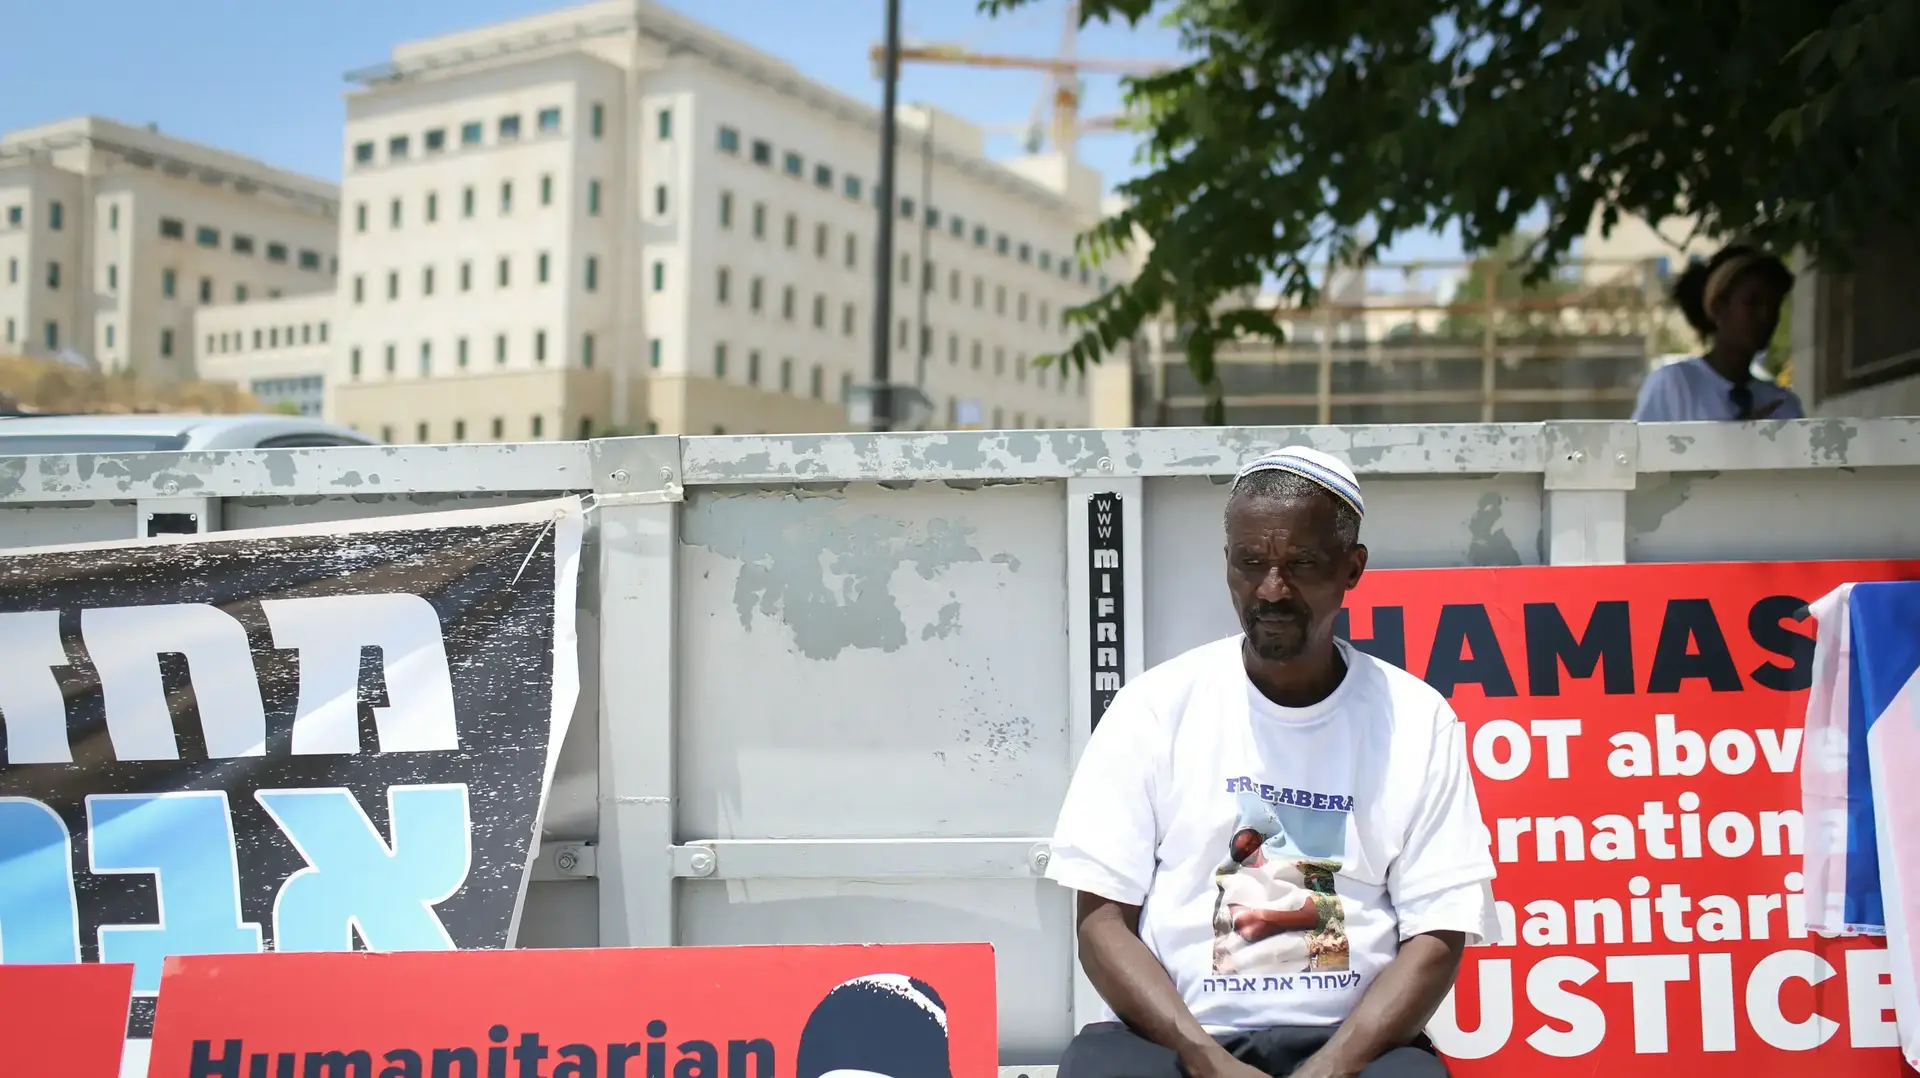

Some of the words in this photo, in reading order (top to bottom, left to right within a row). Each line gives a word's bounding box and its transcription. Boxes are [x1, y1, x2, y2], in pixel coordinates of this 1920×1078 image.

[1456, 718, 1582, 781] OT
[1226, 776, 1275, 800] FRE
[1279, 787, 1354, 812] ABERA
[1483, 791, 1846, 863] rnation
[1203, 978, 1256, 992] אברה
[1262, 976, 1293, 991] את
[1300, 971, 1361, 989] לשחרר
[1425, 949, 1901, 1060] USTICE
[189, 1019, 776, 1078] Humanitarian
